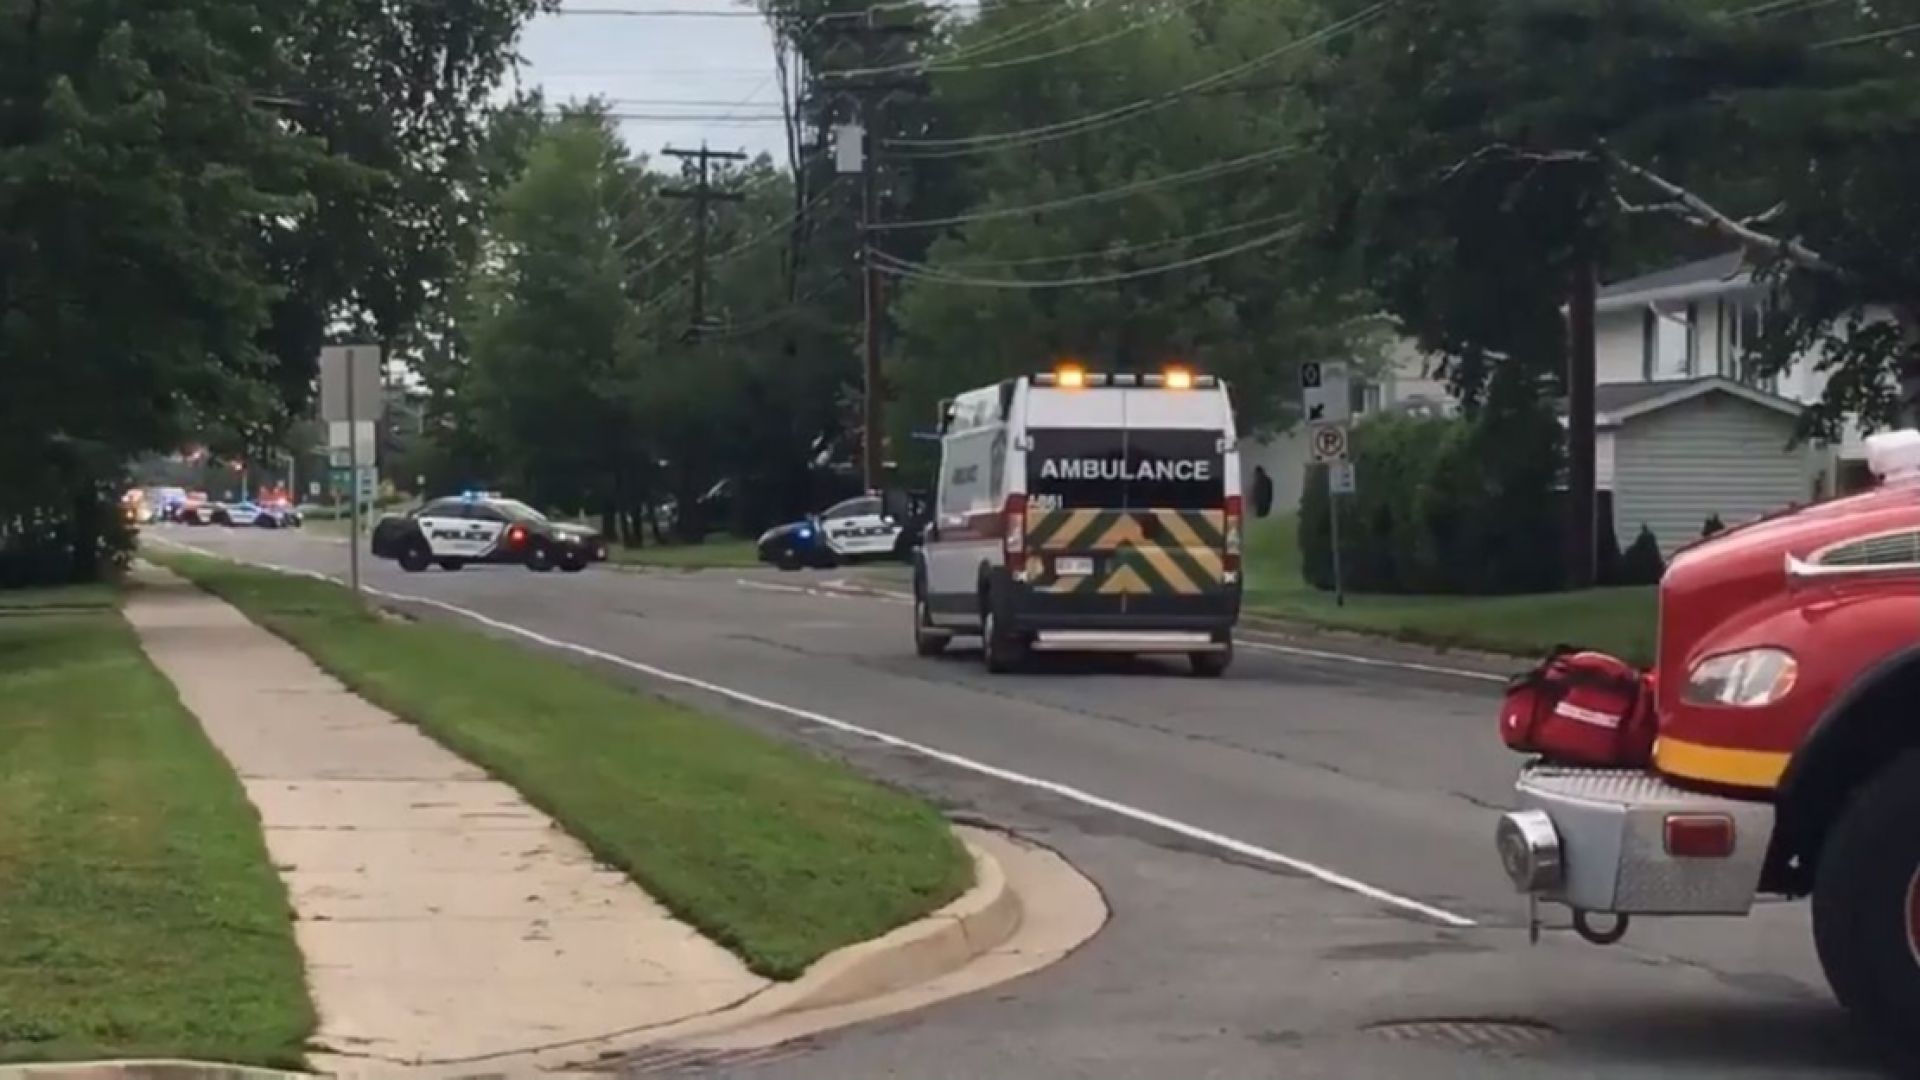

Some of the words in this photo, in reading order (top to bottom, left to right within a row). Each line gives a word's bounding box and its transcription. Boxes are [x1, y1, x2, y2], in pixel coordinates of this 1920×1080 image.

[1323, 433, 1338, 452] P
[1041, 458, 1210, 480] AMBULANCE
[432, 529, 493, 541] POLICE
[832, 526, 893, 539] POLICE
